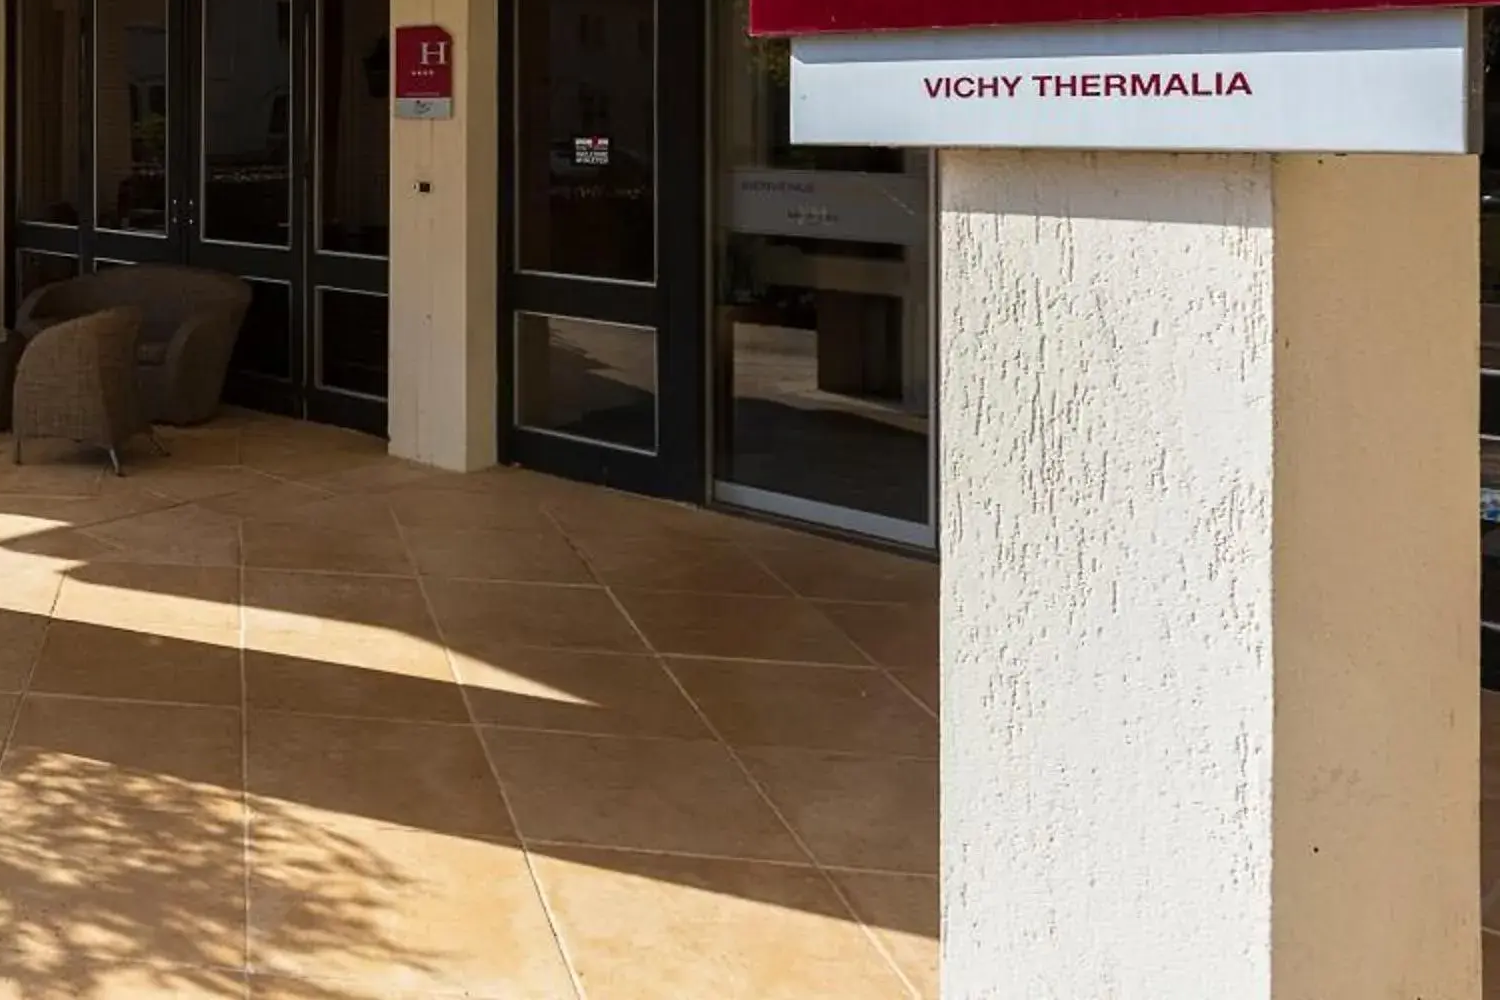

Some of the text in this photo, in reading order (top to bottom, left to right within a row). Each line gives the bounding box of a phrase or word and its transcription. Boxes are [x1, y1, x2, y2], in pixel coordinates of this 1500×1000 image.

[420, 41, 448, 65] H
[924, 72, 1253, 98] VICHY THERMALIA
